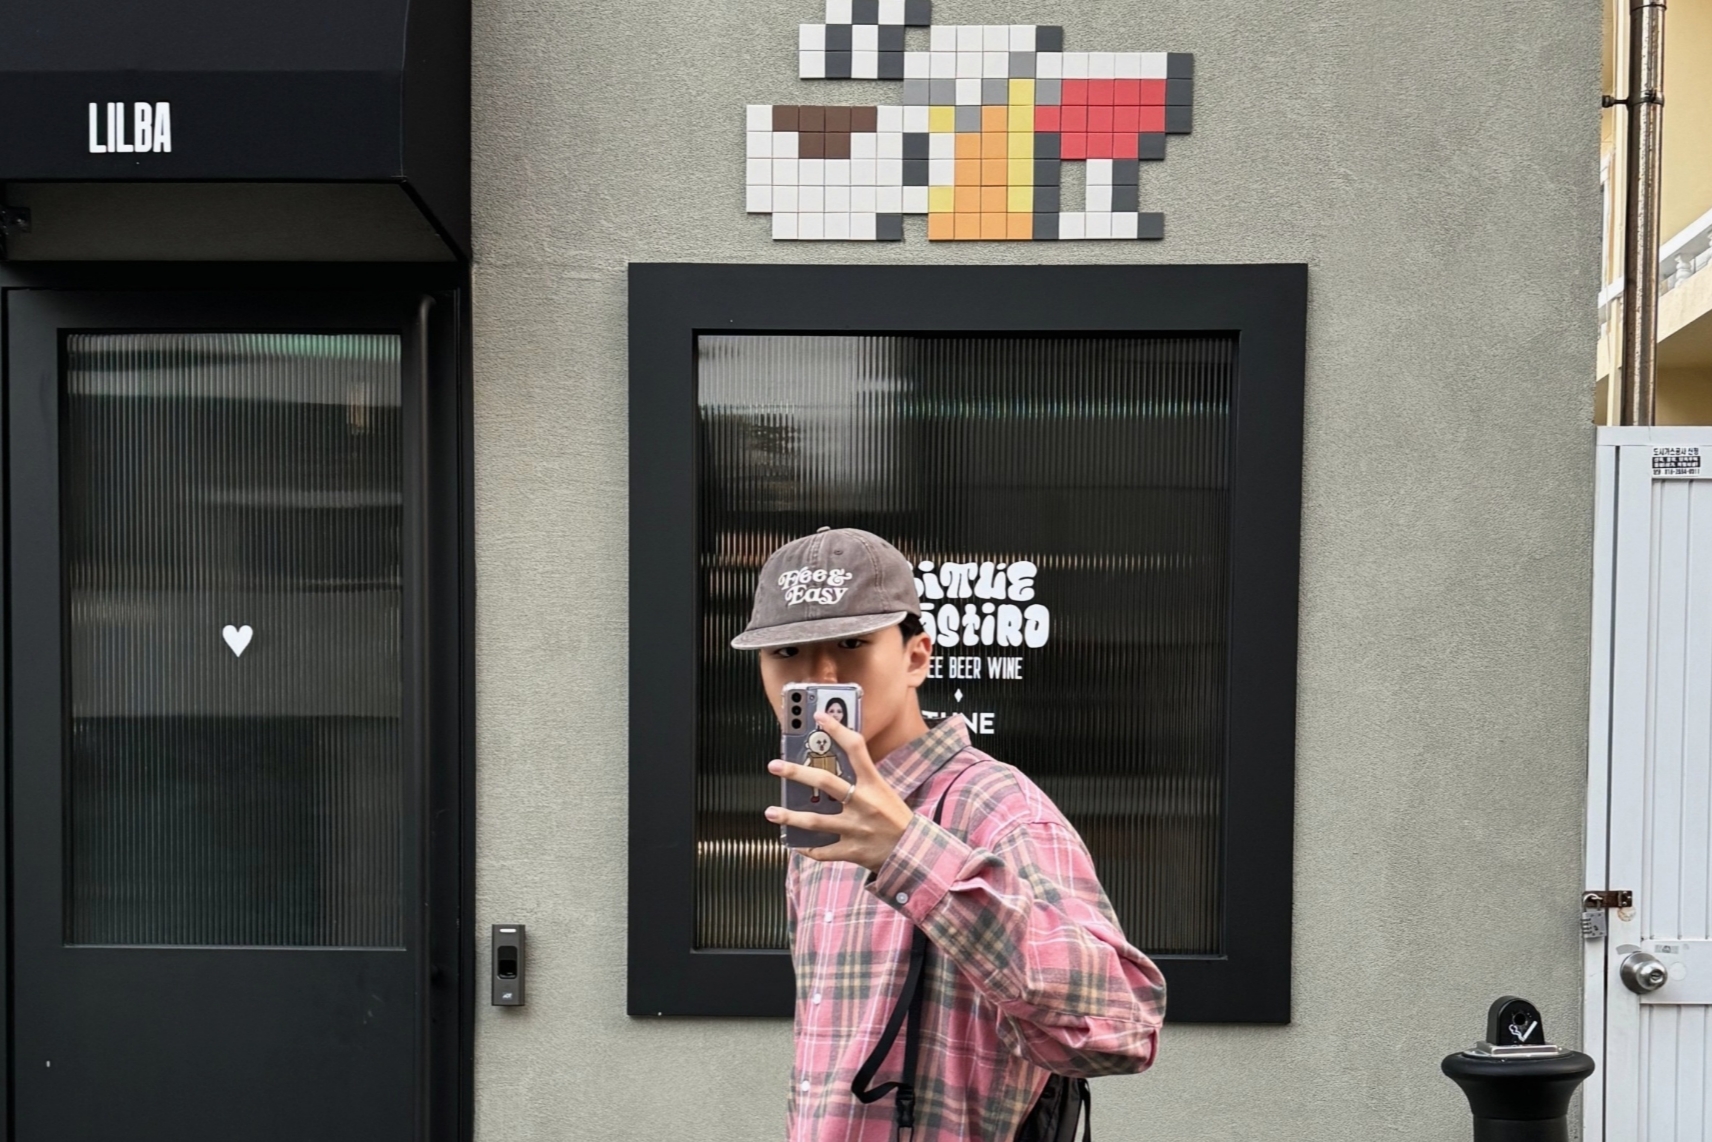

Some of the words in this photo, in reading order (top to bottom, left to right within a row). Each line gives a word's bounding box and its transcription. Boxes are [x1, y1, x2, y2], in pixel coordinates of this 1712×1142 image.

[89, 102, 172, 153] LILBA
[785, 584, 849, 606] Easy
[949, 656, 981, 680] BEER
[987, 657, 1023, 680] WINE
